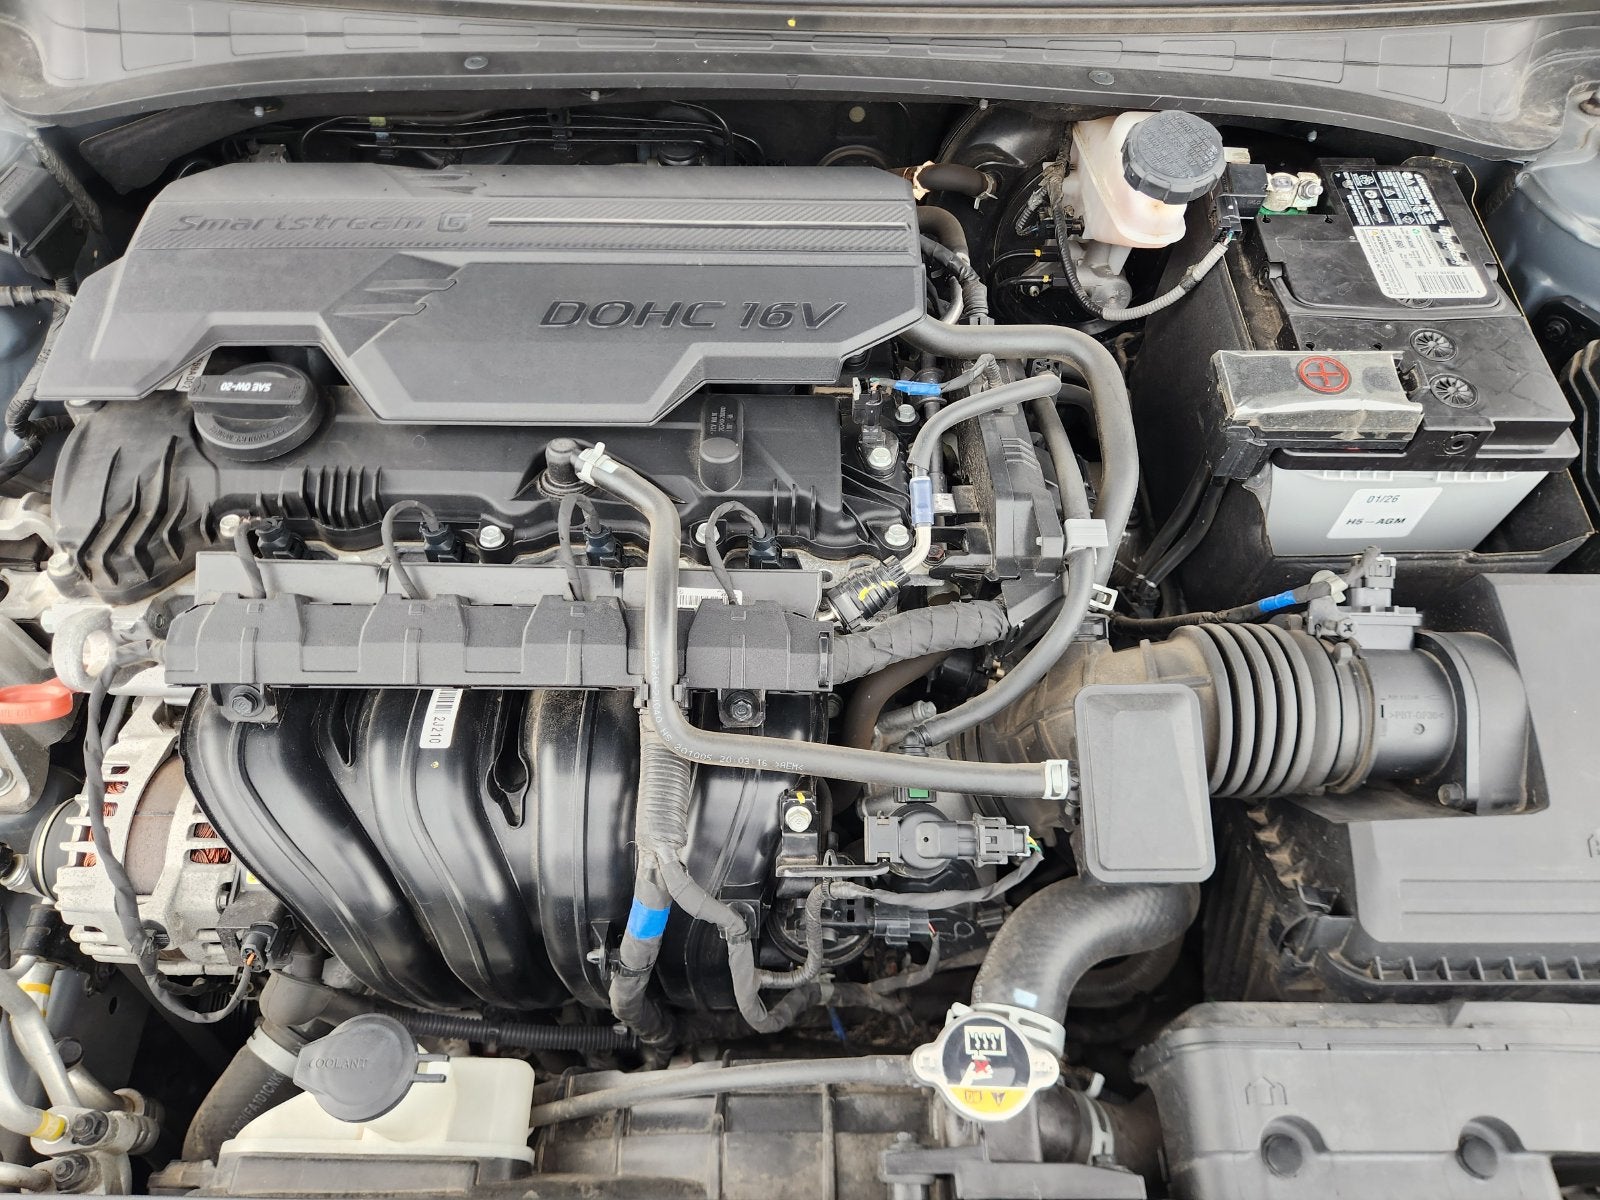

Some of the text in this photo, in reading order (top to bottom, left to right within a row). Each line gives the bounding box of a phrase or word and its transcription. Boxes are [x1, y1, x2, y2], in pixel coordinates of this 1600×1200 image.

[169, 214, 426, 232] Smartstream
[538, 300, 847, 330] DOHC 16V
[220, 381, 272, 392] SAE 0W-20
[1366, 495, 1400, 503] 01/26
[428, 716, 446, 743] 2J210
[308, 1057, 369, 1070] COOLANT
